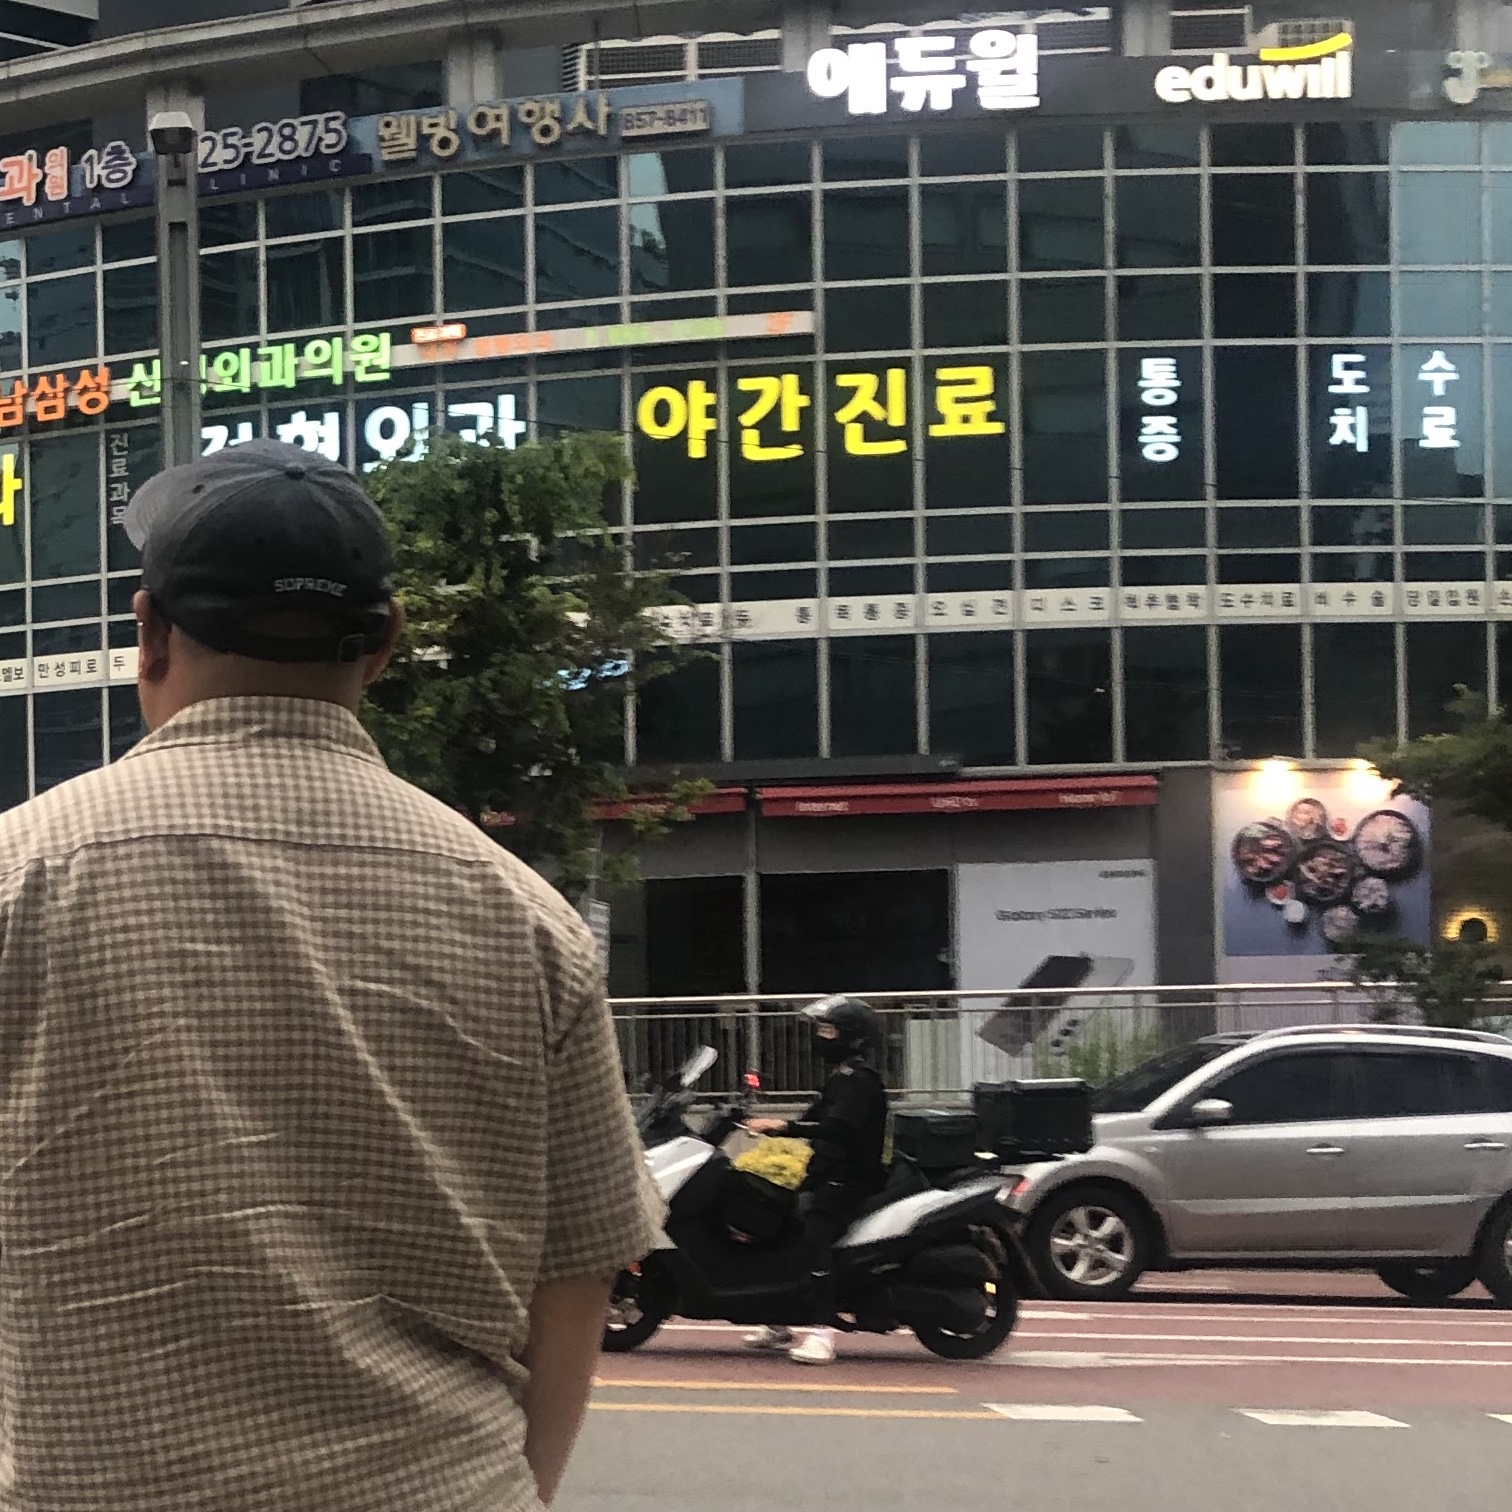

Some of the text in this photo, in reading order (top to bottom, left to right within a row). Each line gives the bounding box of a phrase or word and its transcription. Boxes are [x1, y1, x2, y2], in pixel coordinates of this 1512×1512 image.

[807, 30, 1040, 115] 에듀윌
[1154, 48, 1354, 103] eduwill
[81, 140, 136, 189] 1층
[208, 160, 345, 191] LINIC
[127, 331, 393, 409] 신외과의원
[637, 364, 1007, 462] 야간진료
[1137, 355, 1183, 464] 통증
[273, 576, 348, 597] SUPREME
[37, 658, 98, 679] 만성피로
